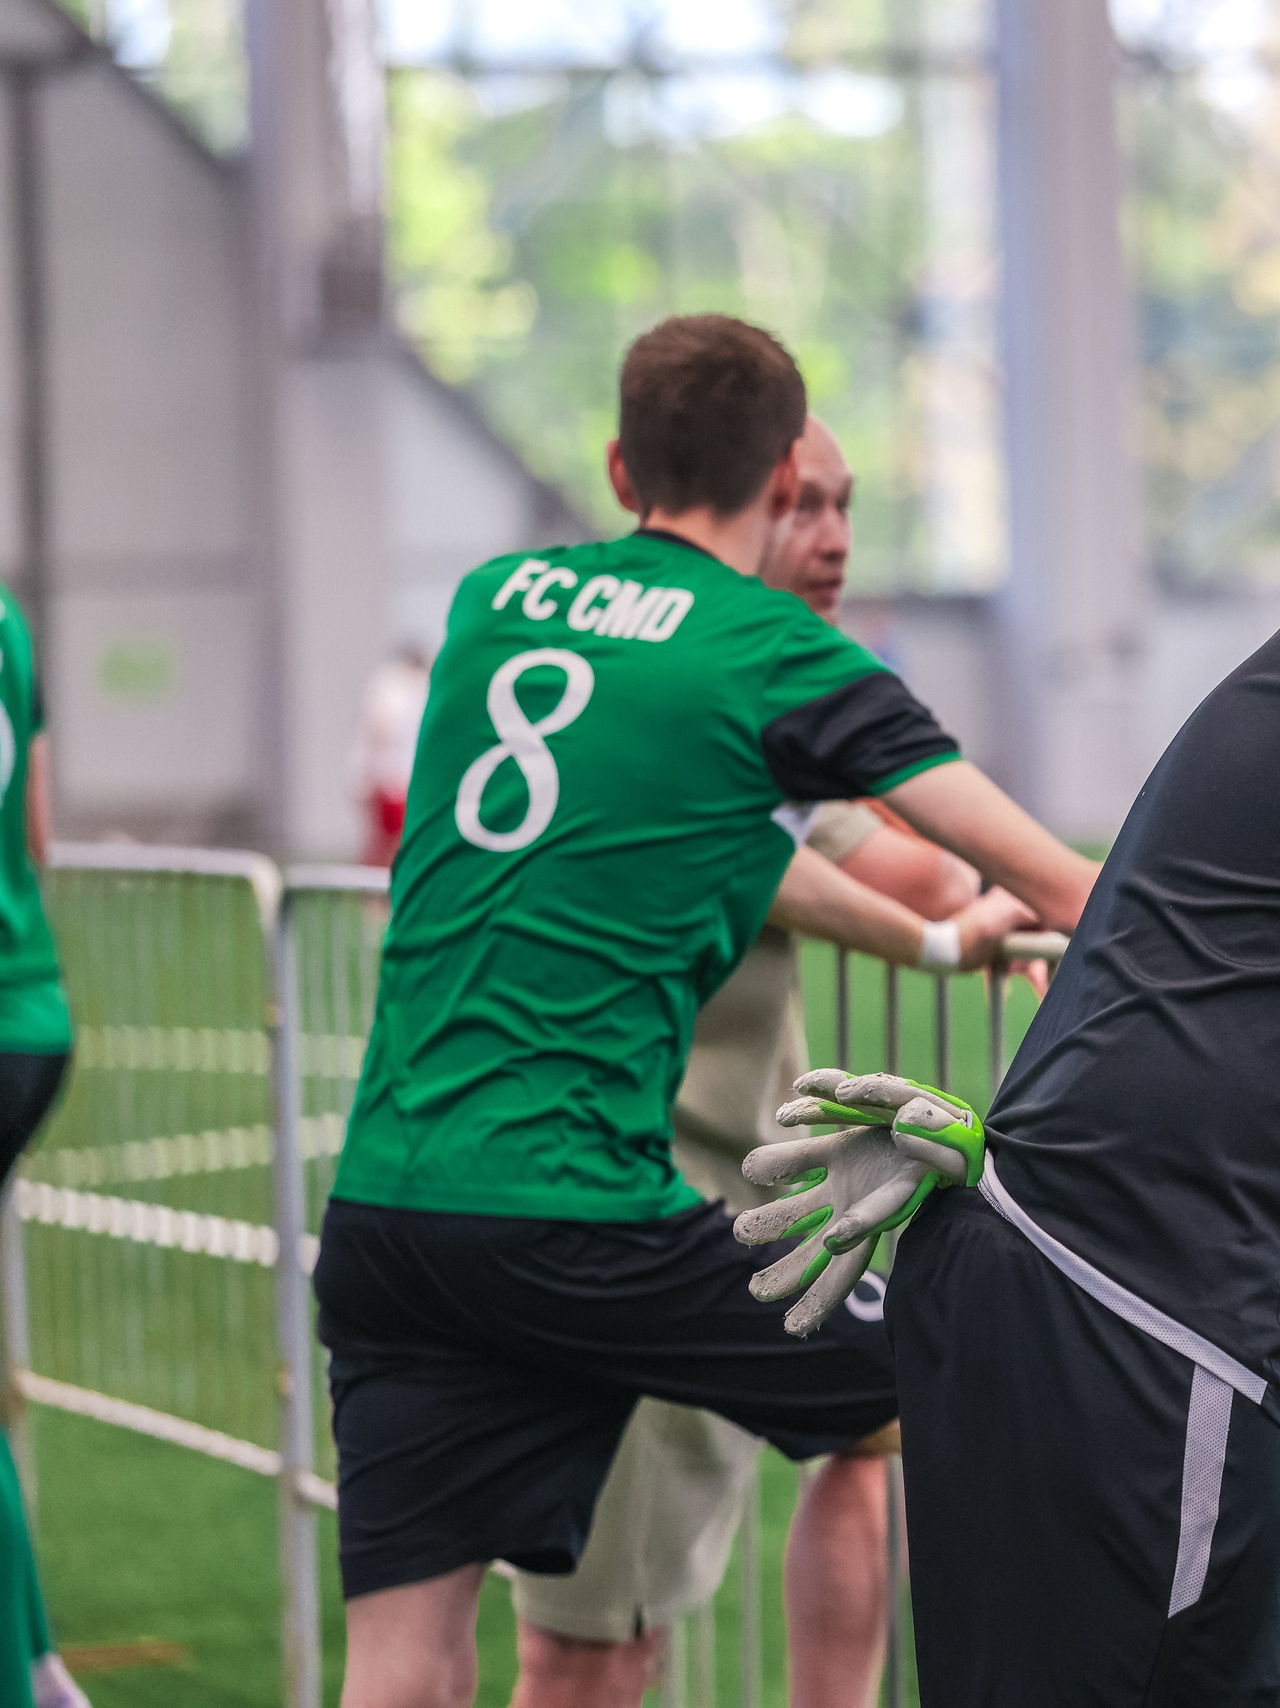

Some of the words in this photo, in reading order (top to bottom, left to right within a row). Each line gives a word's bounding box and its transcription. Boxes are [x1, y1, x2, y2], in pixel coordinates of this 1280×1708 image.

[492, 558, 578, 620] FC
[567, 574, 695, 642] CMD
[455, 647, 595, 852] 8
